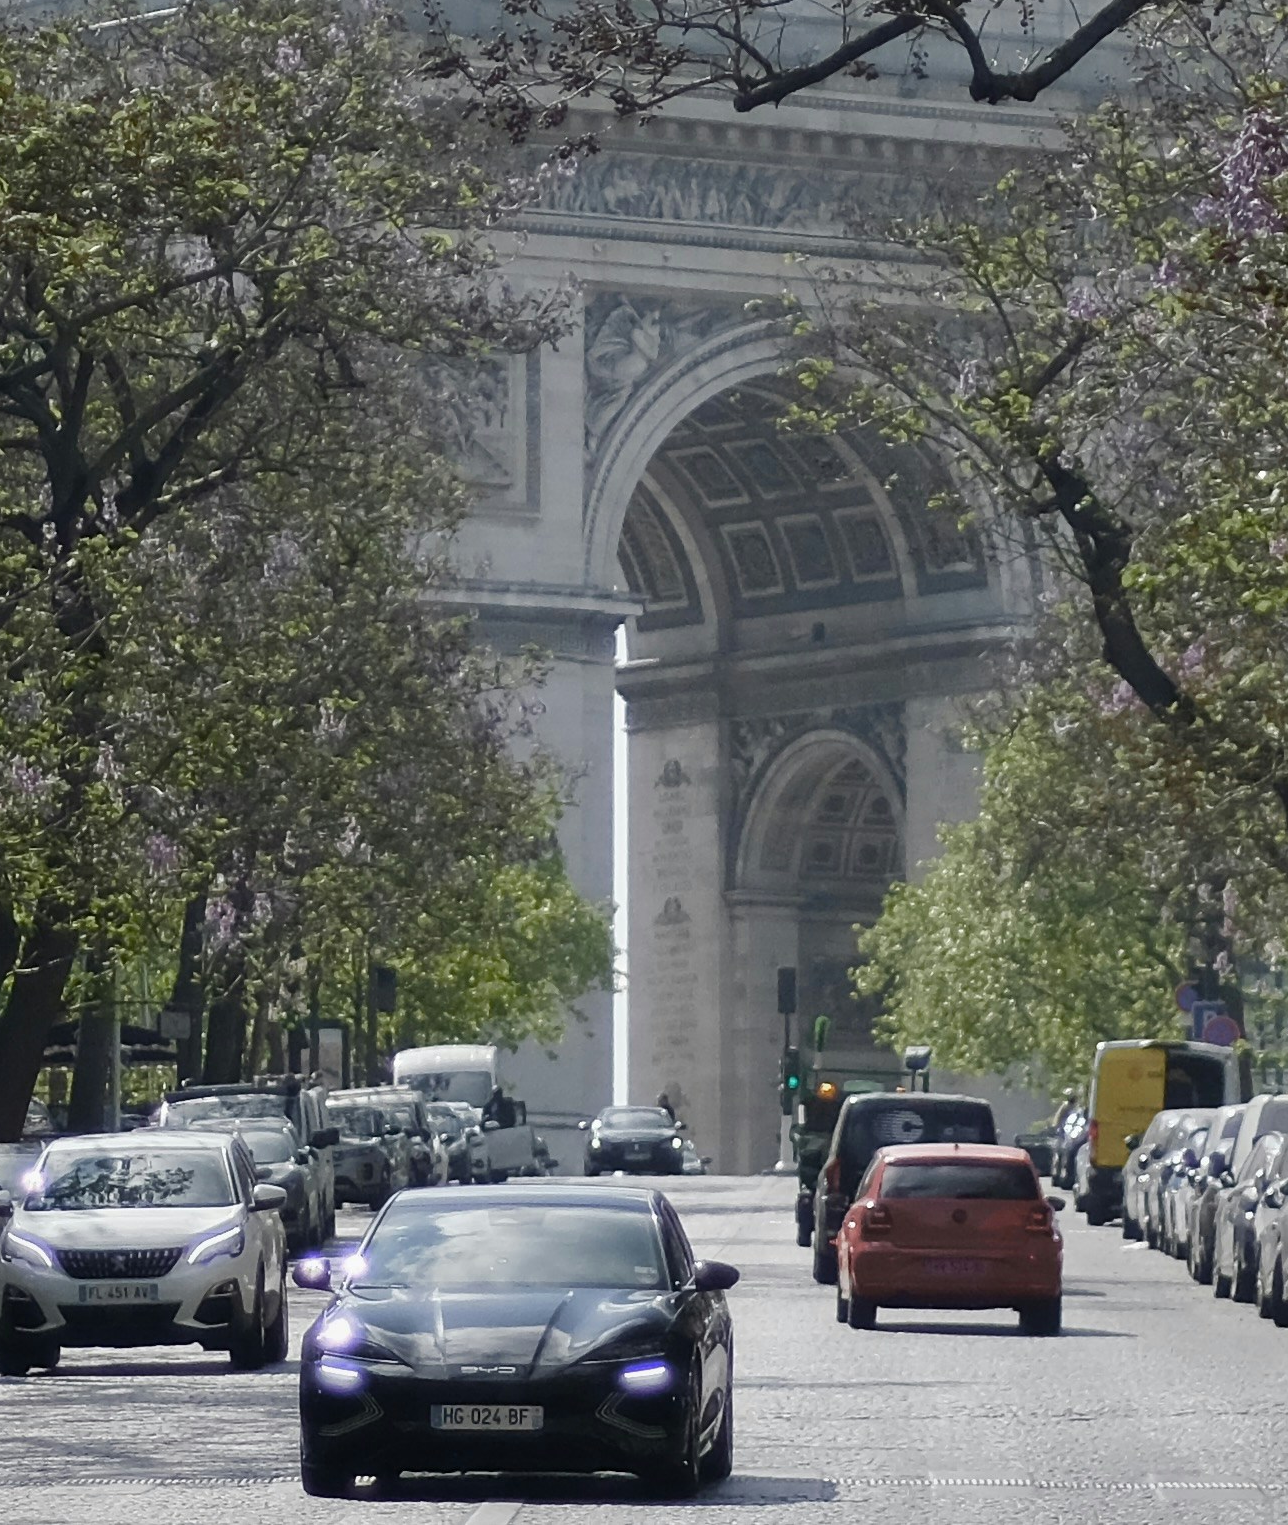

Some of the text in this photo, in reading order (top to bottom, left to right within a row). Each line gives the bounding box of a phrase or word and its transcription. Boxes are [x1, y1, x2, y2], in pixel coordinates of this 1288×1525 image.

[460, 1366, 516, 1374] BYD
[443, 1407, 529, 1426] HG 024 BF
